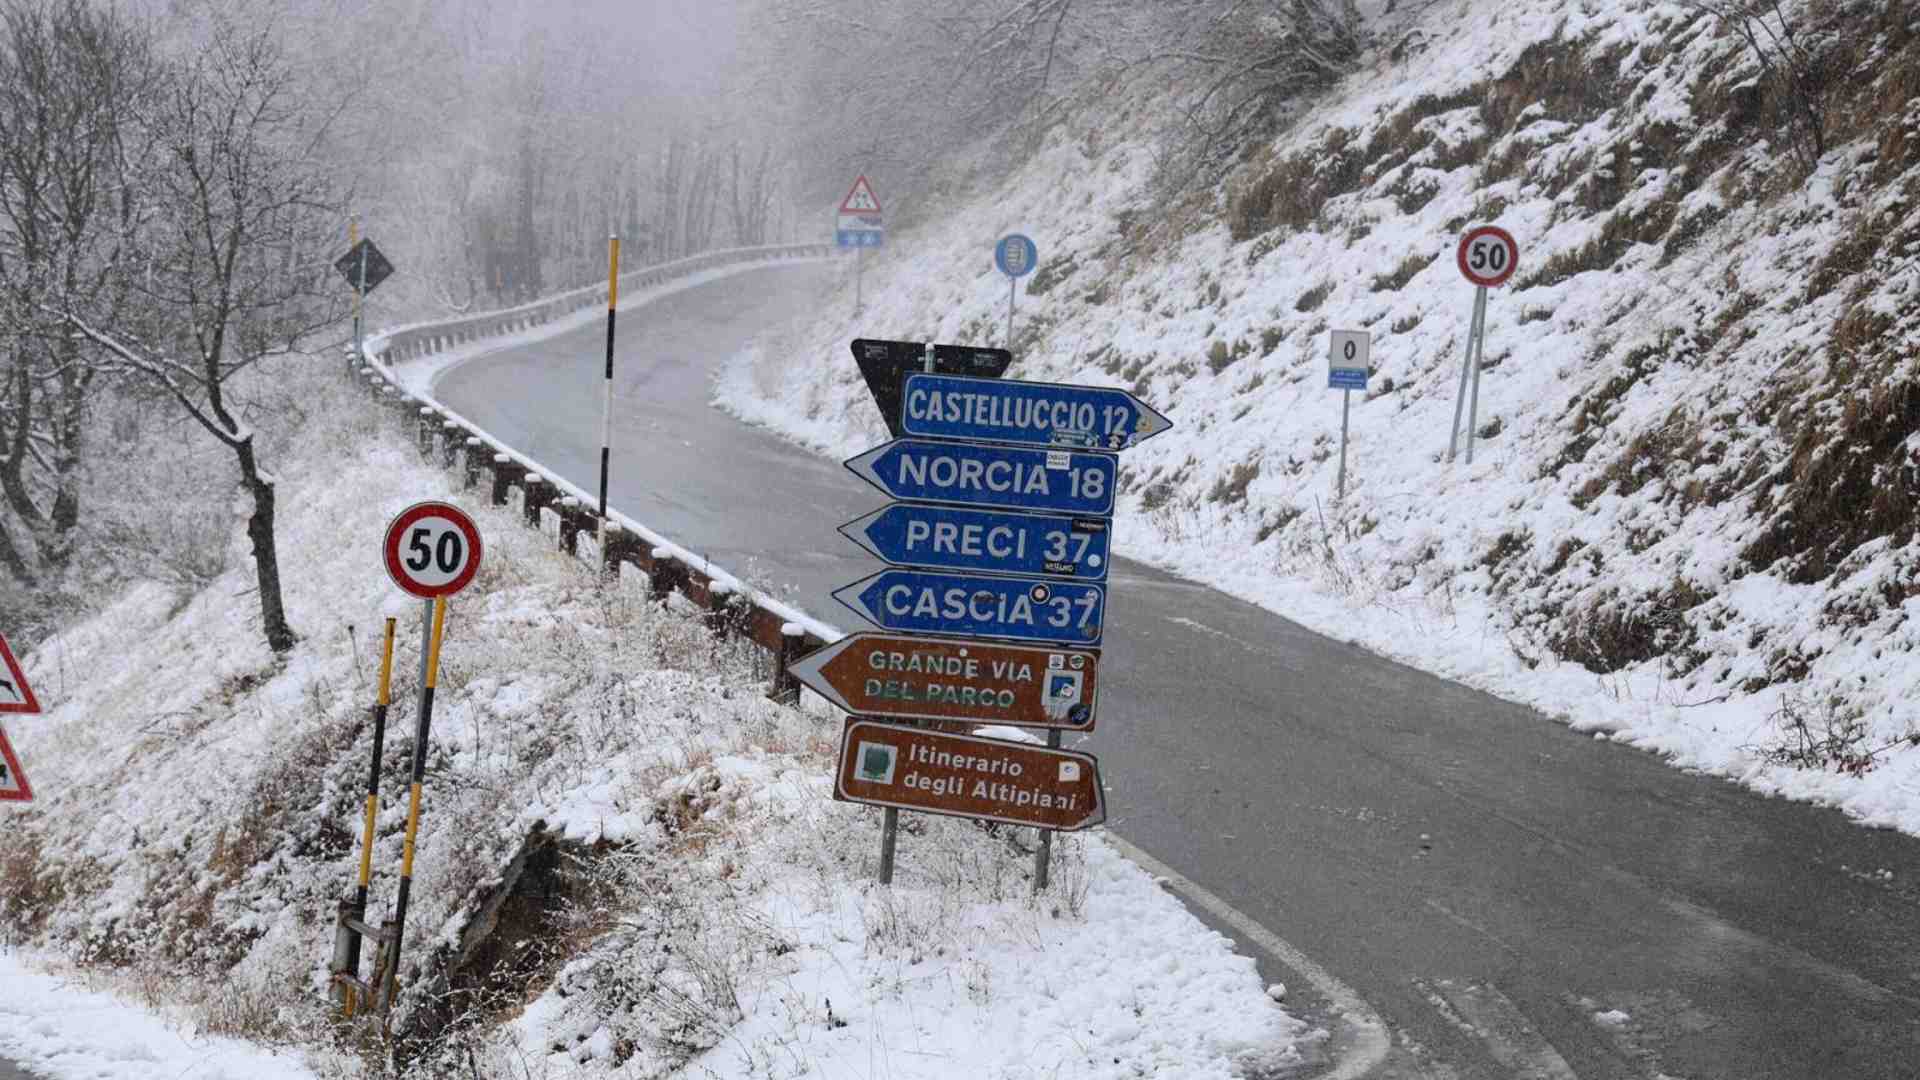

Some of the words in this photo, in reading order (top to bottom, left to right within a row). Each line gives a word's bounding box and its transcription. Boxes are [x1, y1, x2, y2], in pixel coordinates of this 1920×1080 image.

[1471, 241, 1505, 270] 50
[1344, 340, 1356, 360] 0
[908, 389, 1095, 431] CASTELLUCCIO
[1103, 405, 1129, 436] 12
[898, 453, 1050, 495] NORCIA
[1068, 466, 1105, 499] 18
[406, 528, 462, 573] 50
[906, 520, 1026, 559] PRECI
[1044, 530, 1091, 563] 37
[885, 584, 1035, 625] CASCIA
[1048, 595, 1098, 629] 37
[868, 651, 979, 678] GRANDE
[992, 660, 1032, 682] VIA
[865, 678, 914, 699] DEL
[927, 683, 1015, 708] PARCO
[909, 743, 1023, 776] Itinerario
[903, 772, 963, 796] degli
[972, 780, 1077, 811] Altipiani
